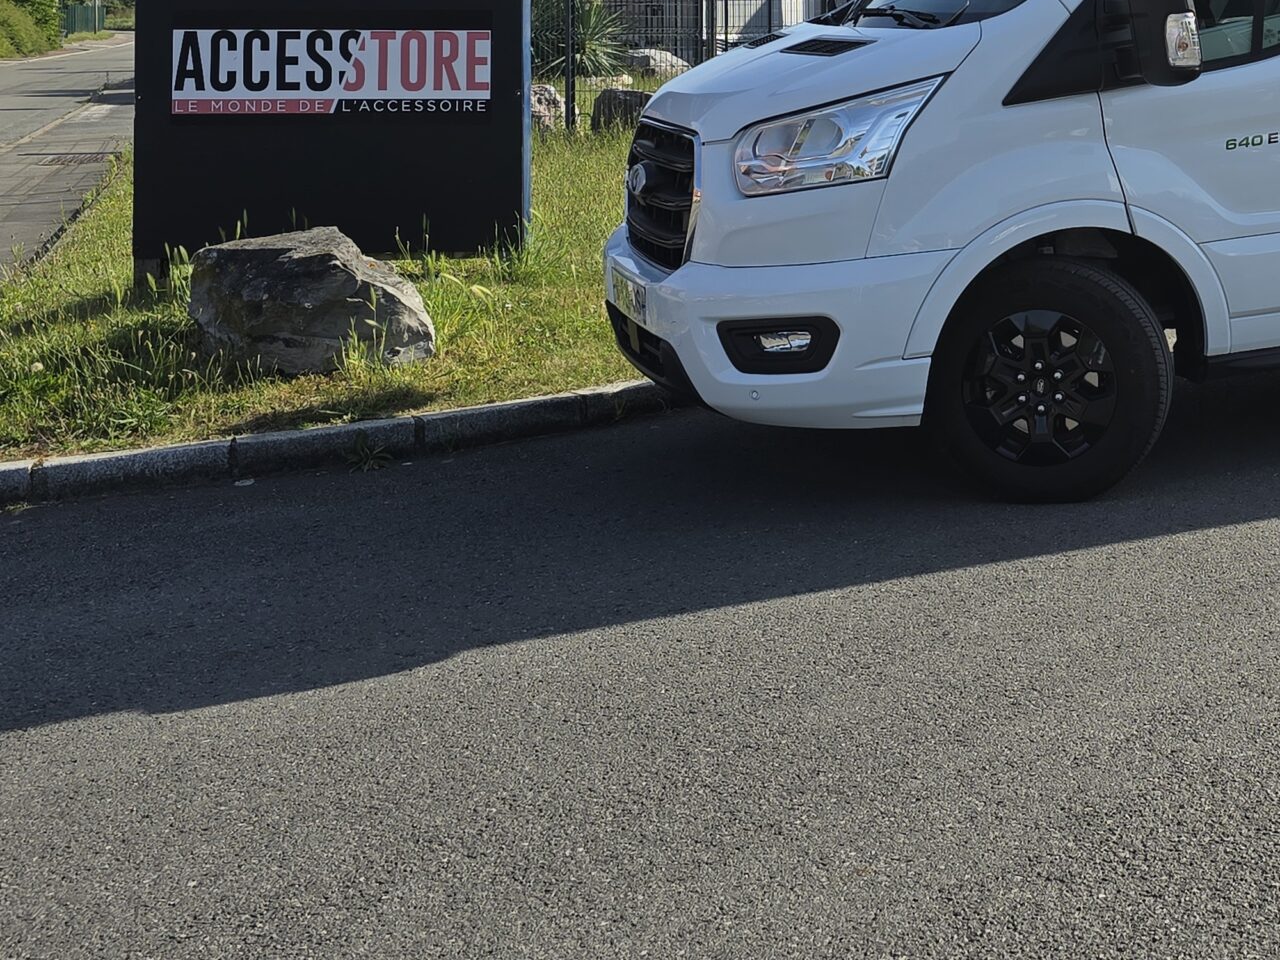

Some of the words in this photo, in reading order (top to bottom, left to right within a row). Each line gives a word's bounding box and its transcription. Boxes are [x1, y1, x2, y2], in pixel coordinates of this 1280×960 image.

[173, 30, 491, 92] ACCESSTORE
[174, 100, 198, 112] LE
[211, 100, 287, 112] MONDE
[299, 100, 325, 112] DE
[341, 99, 487, 112] L'ACCESSOIRE
[1225, 135, 1264, 150] 640
